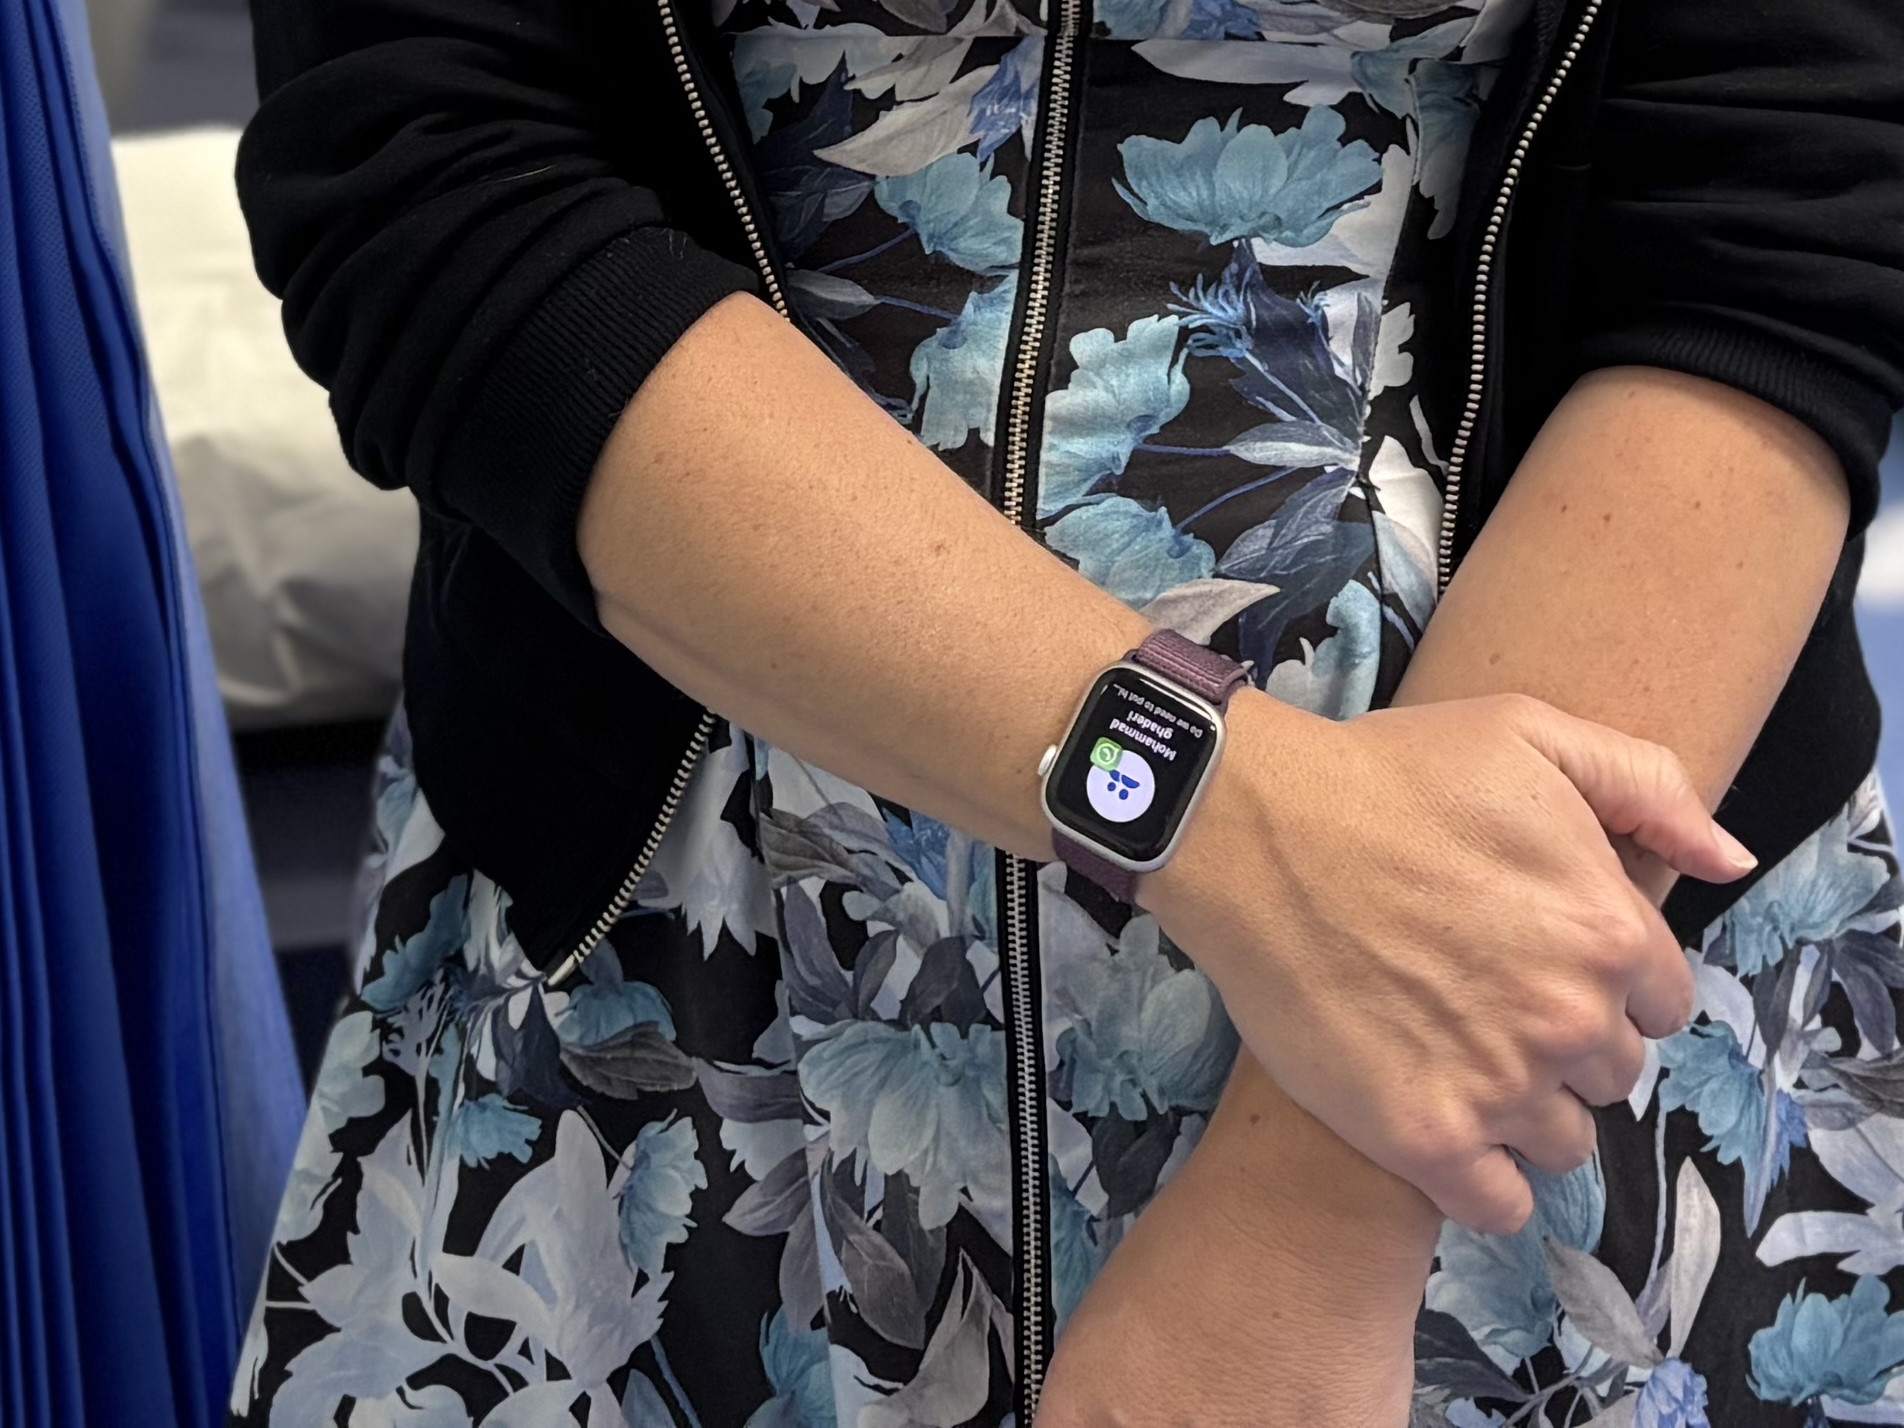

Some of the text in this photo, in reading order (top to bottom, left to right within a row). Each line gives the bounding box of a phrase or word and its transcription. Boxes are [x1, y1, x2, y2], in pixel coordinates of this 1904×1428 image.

[1144, 700, 1155, 712] to
[1126, 710, 1174, 739] ghaderi
[1109, 718, 1177, 761] Mohammad
